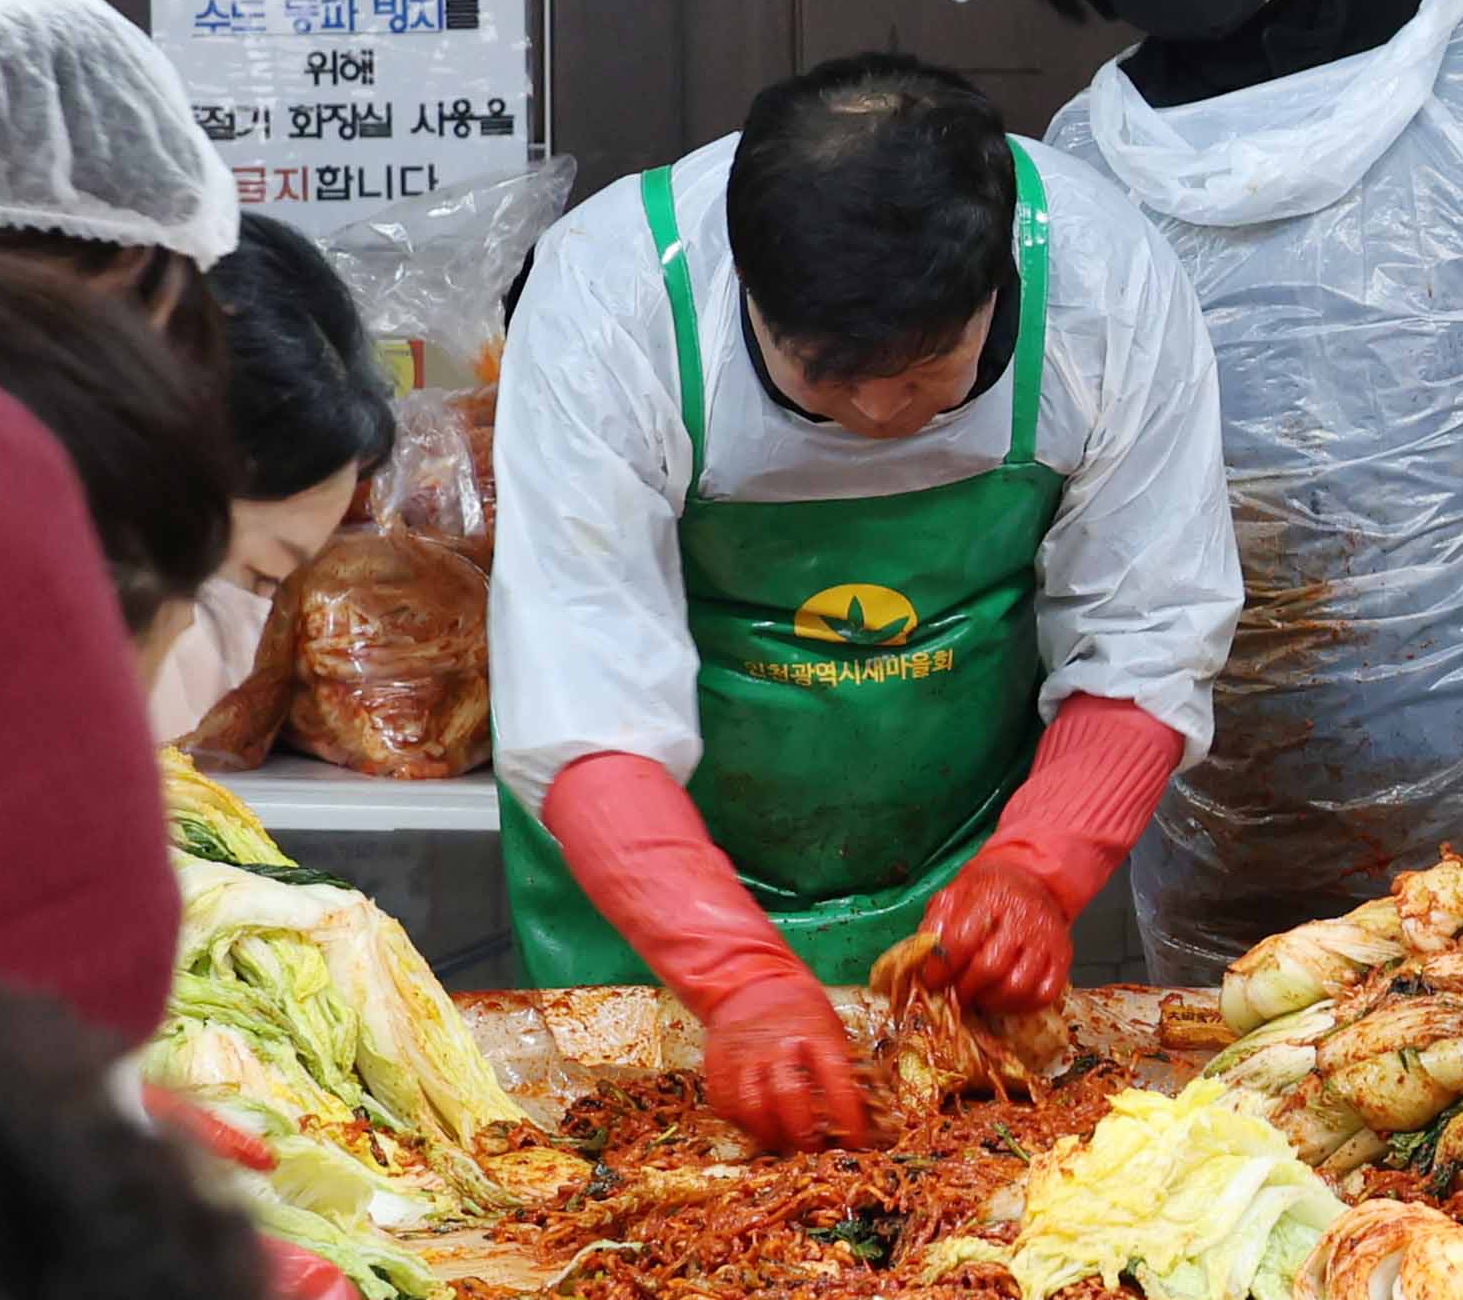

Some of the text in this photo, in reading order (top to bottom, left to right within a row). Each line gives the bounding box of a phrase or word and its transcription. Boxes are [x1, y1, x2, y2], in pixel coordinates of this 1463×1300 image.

[304, 49, 376, 87] 위해
[191, 97, 516, 141] 절기 화장실 사용을
